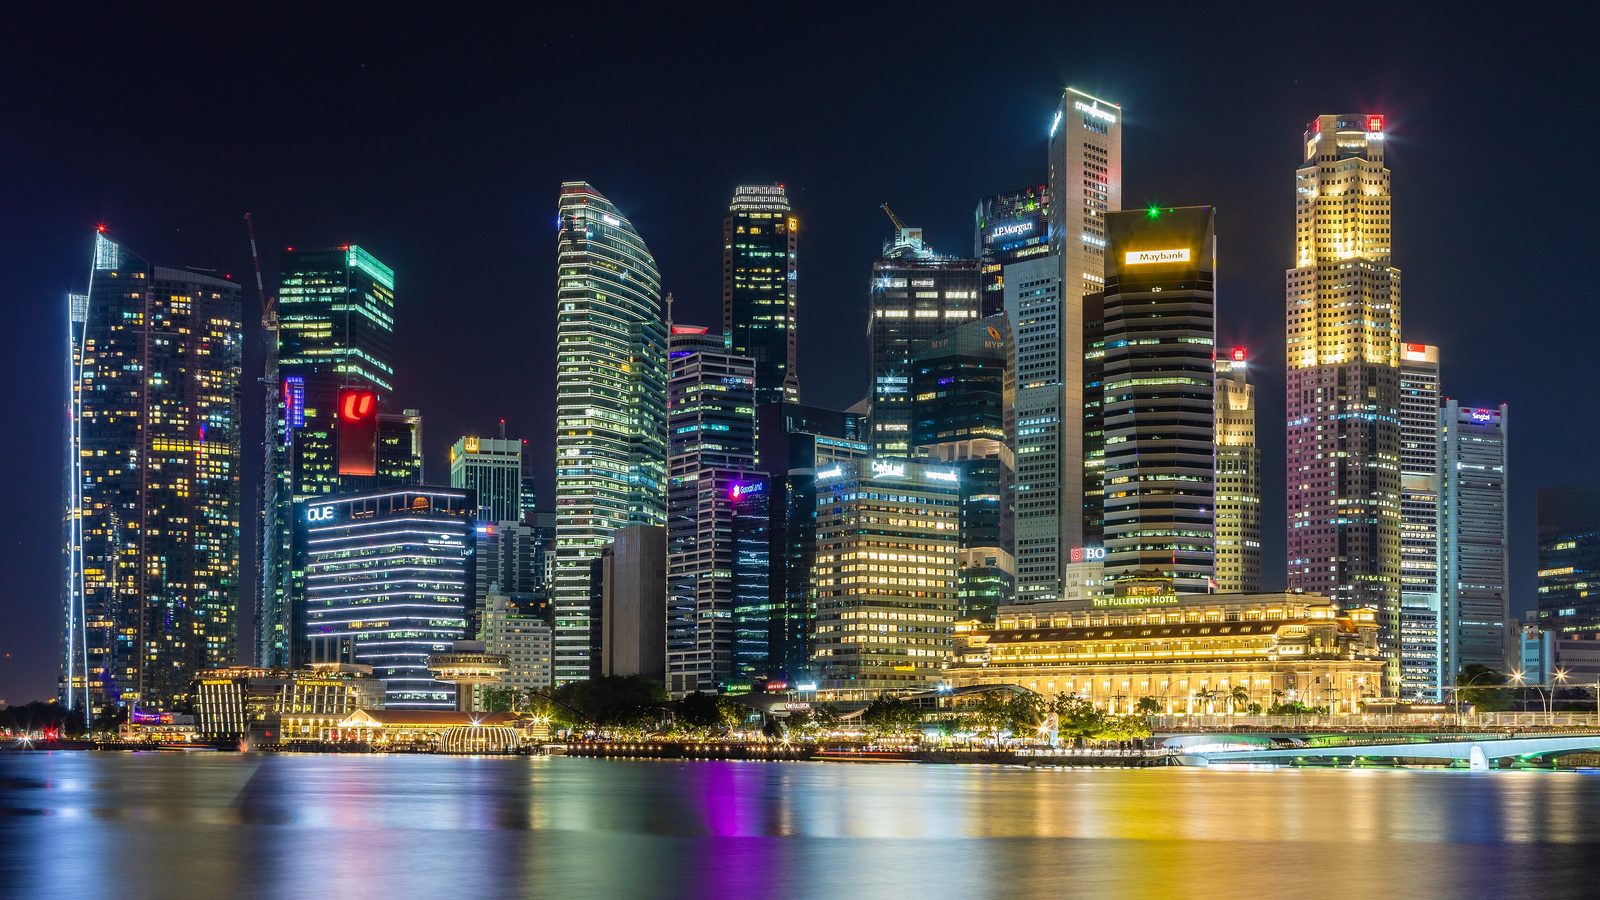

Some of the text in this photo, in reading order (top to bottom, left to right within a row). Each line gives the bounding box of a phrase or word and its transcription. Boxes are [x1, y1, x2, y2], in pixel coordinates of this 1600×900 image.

[1139, 252, 1184, 262] Maybank
[932, 339, 949, 349] MYP
[985, 340, 1005, 349] MYP
[307, 506, 334, 521] OUE
[1093, 595, 1178, 606] THE FULLERTON HOTEL
